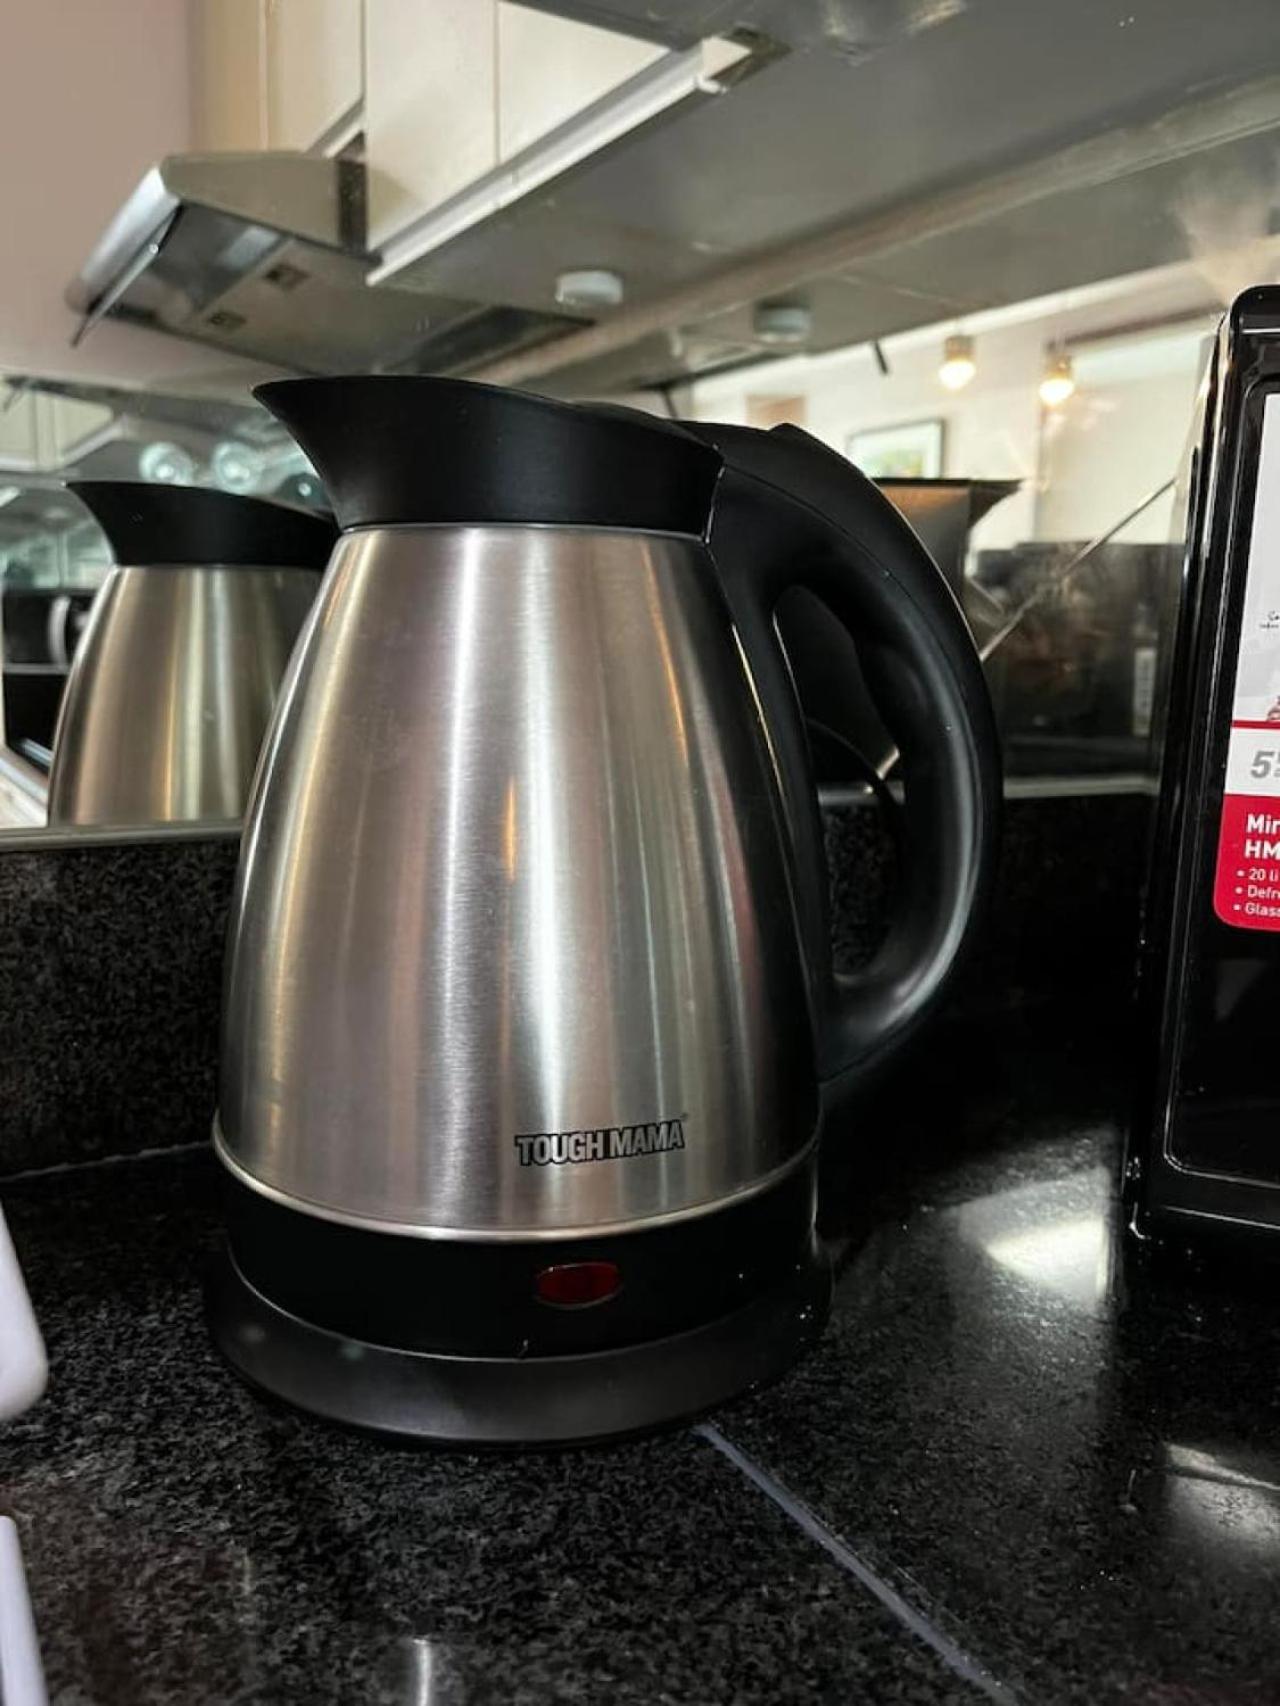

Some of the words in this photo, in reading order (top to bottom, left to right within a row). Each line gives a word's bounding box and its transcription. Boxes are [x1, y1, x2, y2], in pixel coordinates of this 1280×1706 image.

[1248, 868, 1266, 881] 20
[514, 1129, 604, 1166] TOUGH
[606, 1119, 685, 1159] MAMA
